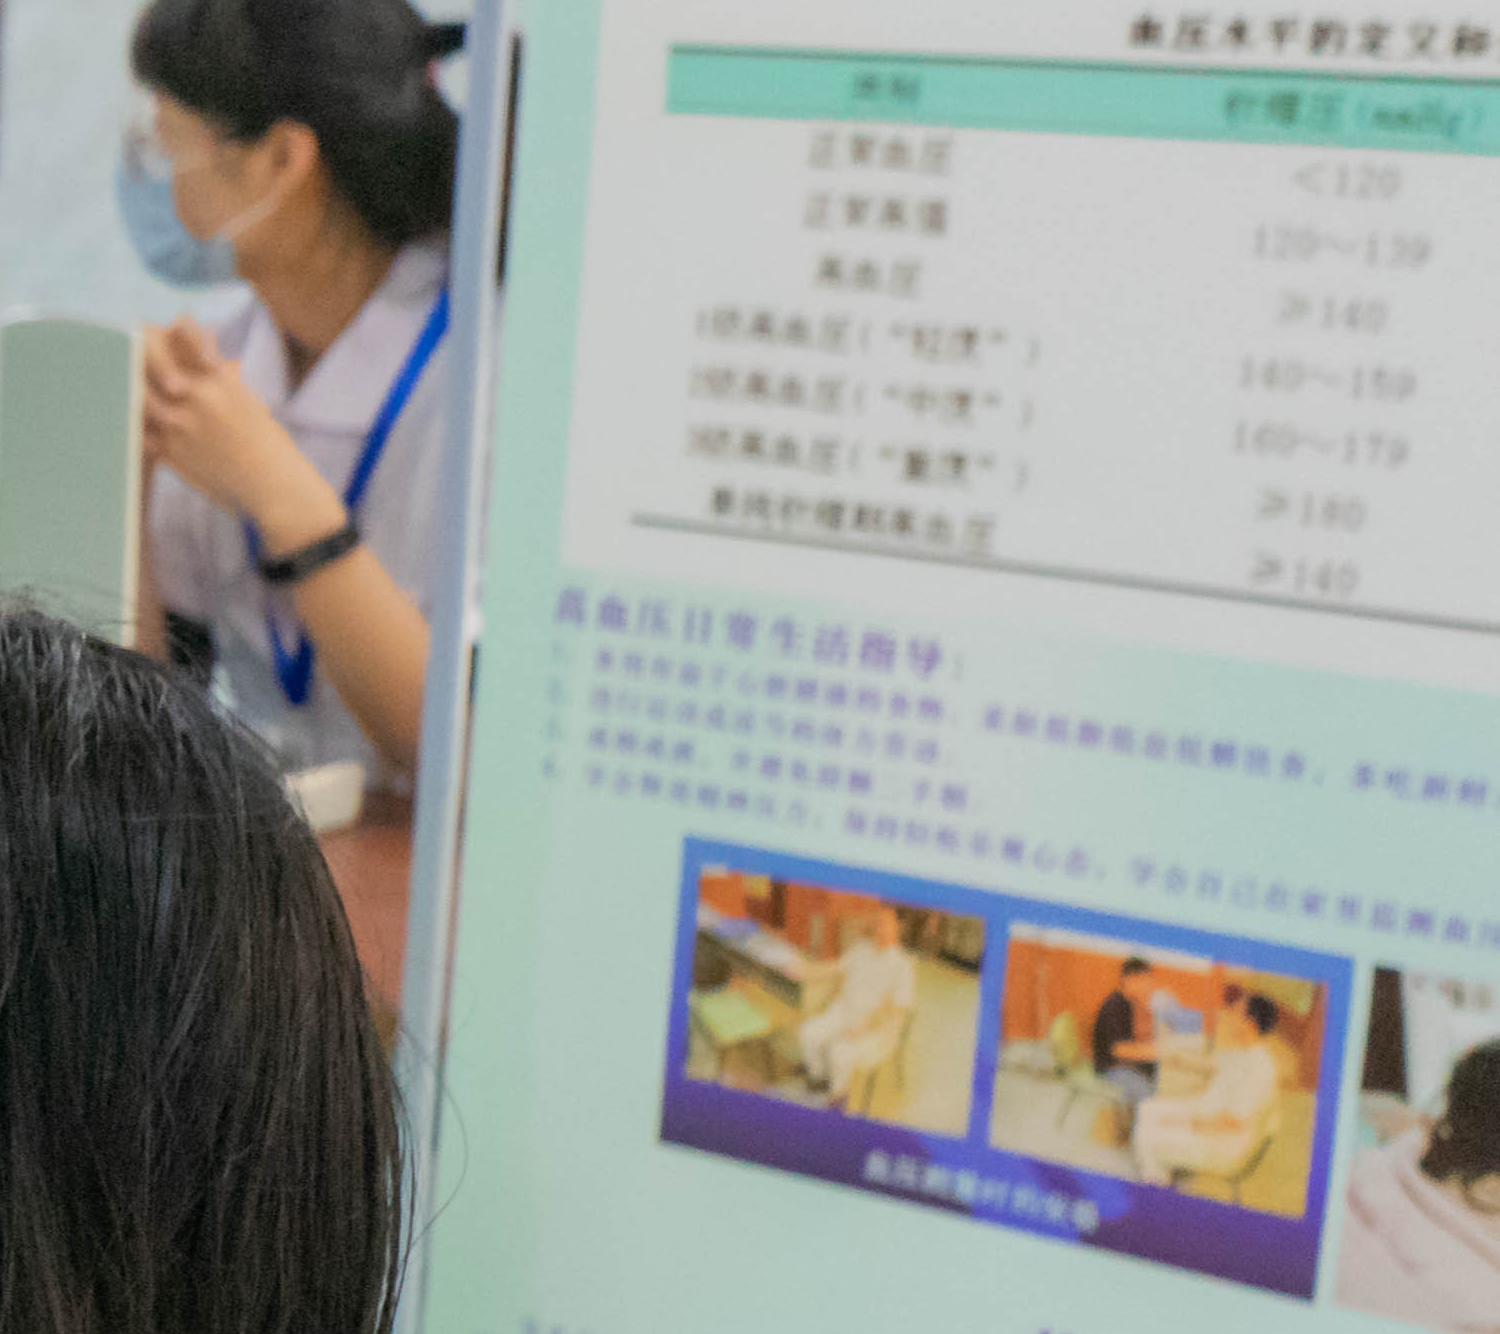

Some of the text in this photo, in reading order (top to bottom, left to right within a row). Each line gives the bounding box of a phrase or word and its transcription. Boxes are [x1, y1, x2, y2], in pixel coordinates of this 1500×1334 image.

[808, 131, 953, 176] 正常血压
[814, 255, 924, 298] 高血压
